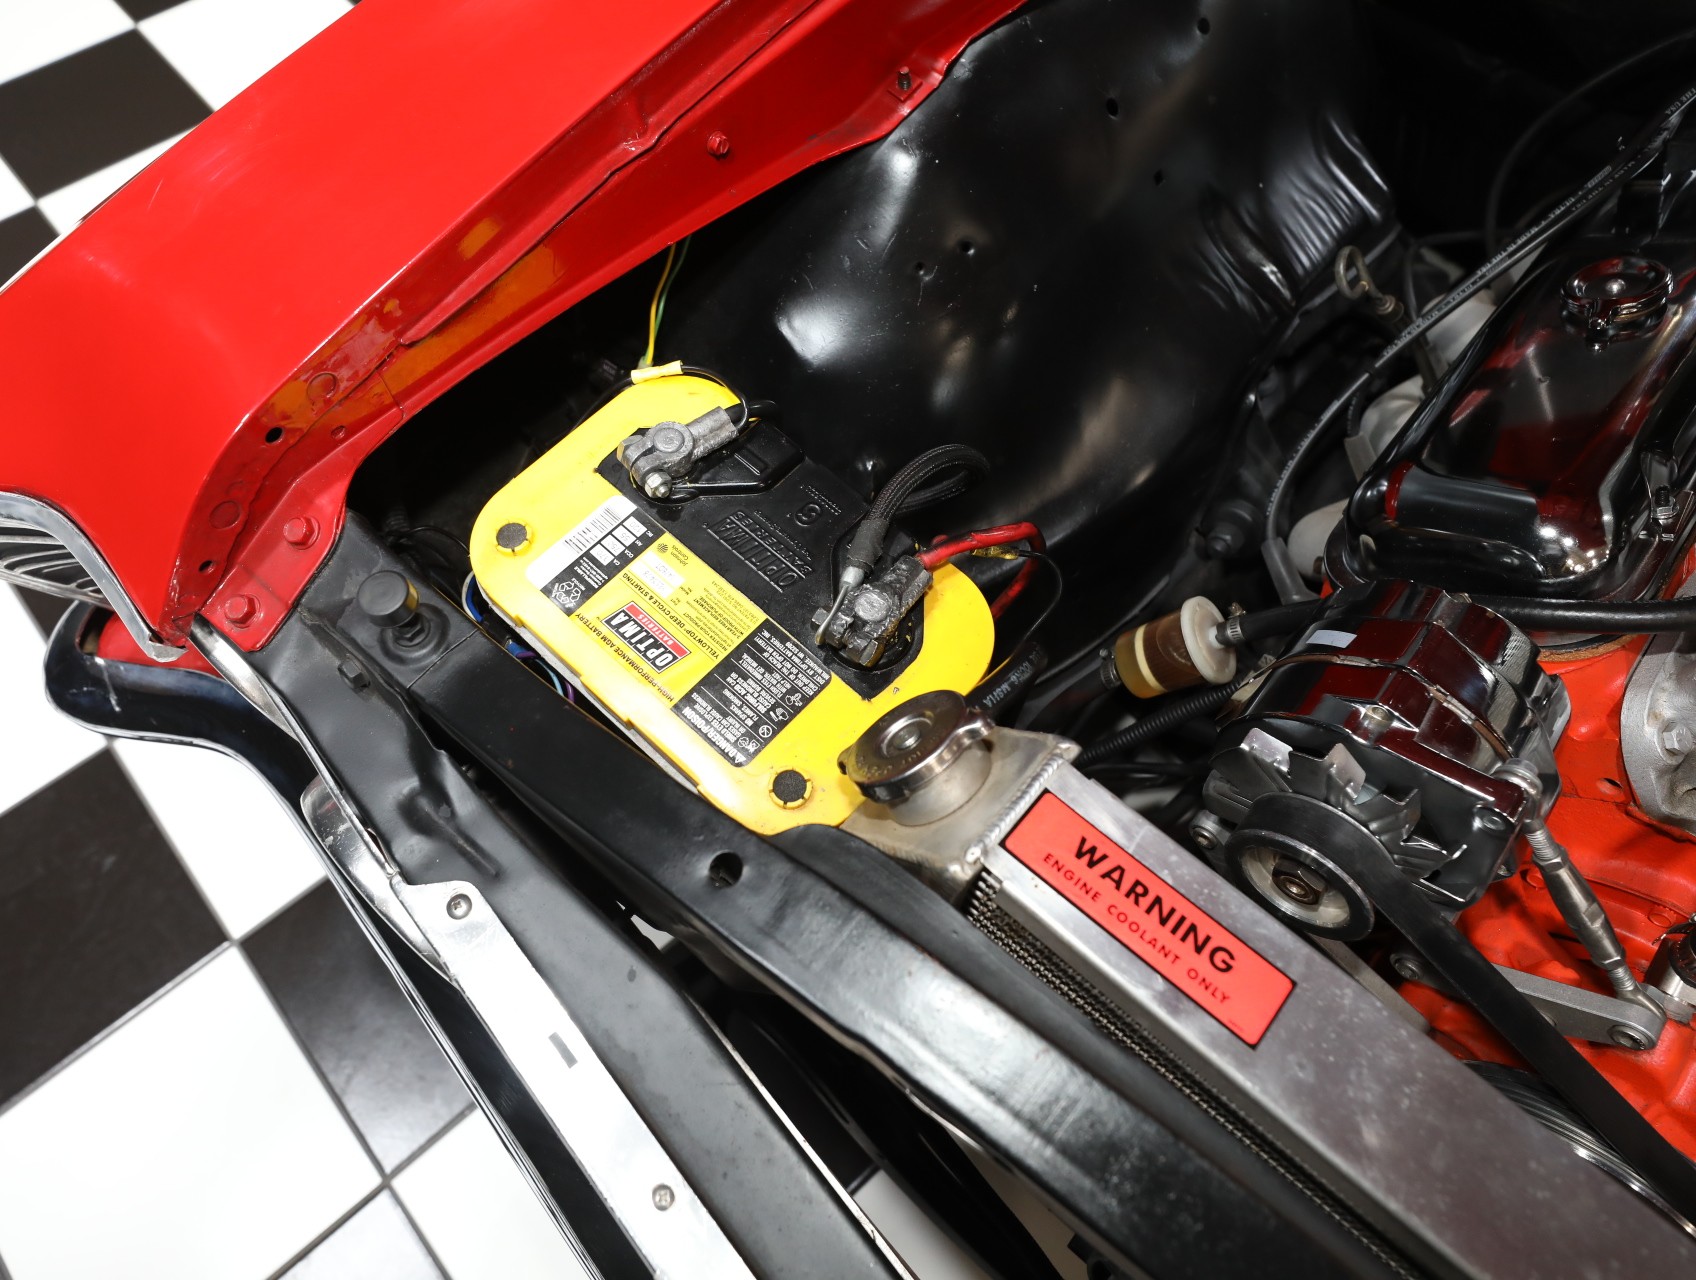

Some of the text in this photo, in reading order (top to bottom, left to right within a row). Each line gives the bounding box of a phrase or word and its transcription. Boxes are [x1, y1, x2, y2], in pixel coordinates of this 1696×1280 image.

[1663, 86, 1696, 117] THE USA
[1547, 194, 1575, 220] ULTRA
[732, 507, 813, 578] BATTERIES
[623, 548, 634, 558] CCA
[669, 550, 688, 567] Johnson
[670, 544, 689, 560] Controls
[715, 516, 799, 591] OPTIMA
[621, 572, 649, 597] STARTING
[651, 598, 671, 616] CYCLE
[692, 597, 719, 620] REPLACEMENT
[668, 613, 685, 628] DEEP
[682, 611, 701, 628] PRODUCT
[636, 612, 674, 645] BATTERIES
[699, 625, 711, 636] YOUR
[609, 610, 674, 669] OPTIMA
[708, 633, 728, 651] REGISTER
[753, 635, 774, 653] BATTERY!
[574, 611, 675, 702] HIGH-PERFORMANCE AGM BATTERY
[761, 650, 770, 658] OF
[771, 650, 784, 662] OPEN
[755, 665, 765, 673] GET
[781, 659, 792, 668] NOT
[789, 665, 799, 674] DO
[790, 654, 808, 670] OPTIMA
[780, 666, 790, 675] THE
[788, 672, 796, 680] OF
[724, 675, 736, 686] CAN
[760, 677, 772, 687] EYES
[775, 682, 787, 693] WITH
[780, 678, 792, 689] HELP
[793, 677, 804, 687] OUT
[722, 687, 743, 706] SMOKING
[733, 683, 747, 695] ACID
[801, 684, 814, 695] KEEP
[709, 708, 723, 721] CAUSE
[744, 717, 754, 726] NO
[710, 718, 724, 731] EYES
[720, 718, 731, 727] CAN
[680, 705, 738, 757] DANGER/POISON
[720, 727, 737, 743] SHIELD
[1074, 836, 1236, 974] WARNING
[1044, 853, 1231, 1004] ENGINE COOLANT ONLY
